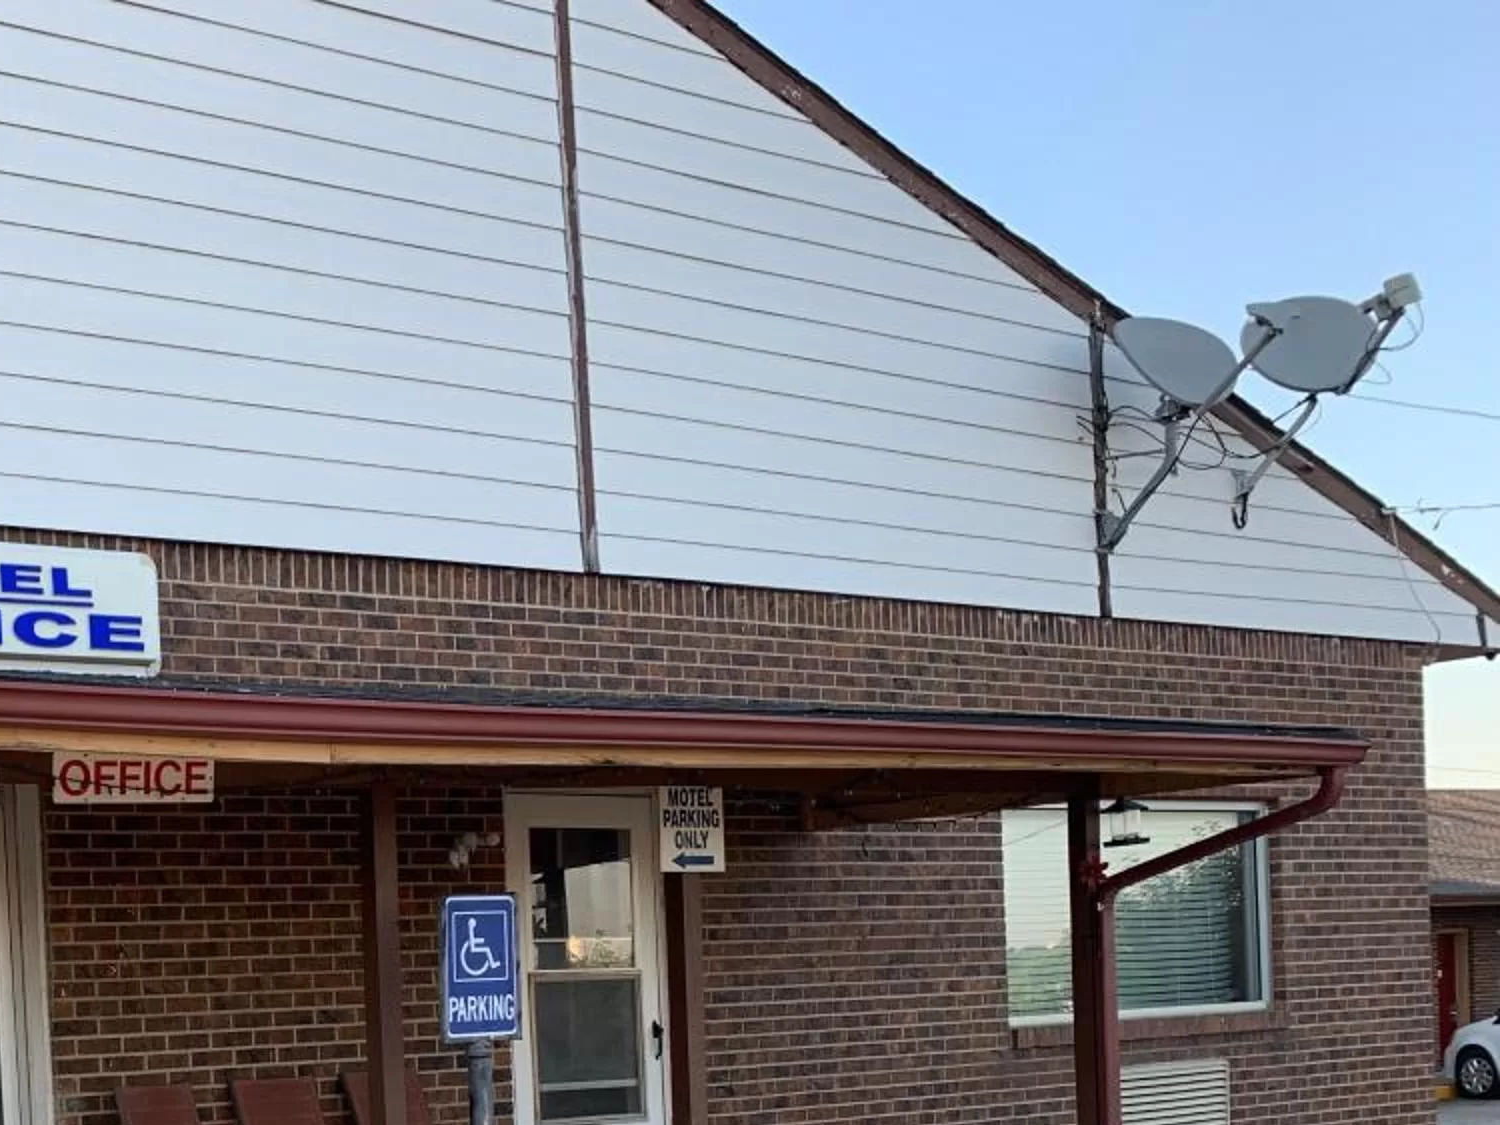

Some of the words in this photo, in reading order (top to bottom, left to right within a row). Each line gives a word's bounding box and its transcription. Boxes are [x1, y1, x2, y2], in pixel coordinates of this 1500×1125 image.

[58, 759, 208, 797] OFFICE
[667, 787, 714, 806] MOTEL
[663, 809, 719, 828] PARKING
[674, 829, 709, 850] ONLY
[449, 994, 515, 1022] PARKING
